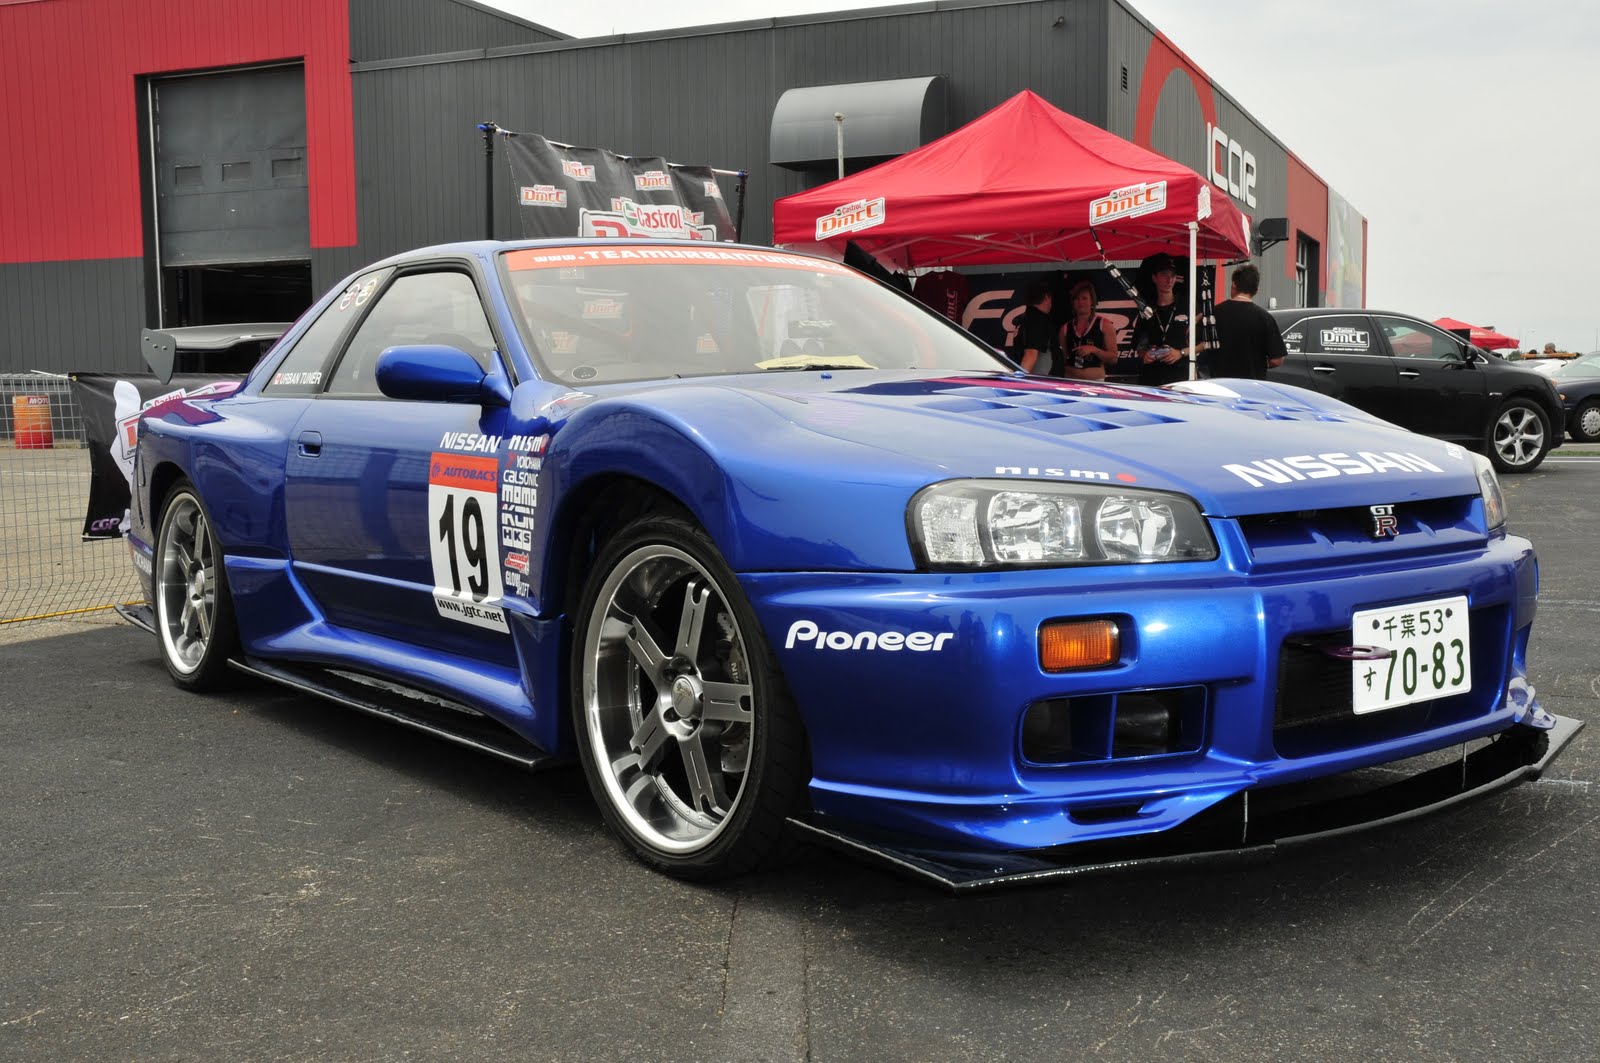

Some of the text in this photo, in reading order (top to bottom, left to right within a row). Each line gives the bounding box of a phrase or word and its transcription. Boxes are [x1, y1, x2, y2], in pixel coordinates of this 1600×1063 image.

[1118, 186, 1141, 198] Castrol
[636, 207, 683, 229] Castrol
[841, 203, 862, 214] Castrol
[439, 432, 502, 453] NISSAN
[444, 467, 496, 482] AUTOBACS
[1221, 451, 1444, 488] NISSAN
[1370, 504, 1395, 516] GT
[503, 528, 531, 545] HKS
[1374, 515, 1399, 537] R
[439, 494, 489, 603] 19
[437, 599, 504, 623] www.jgtc.net
[785, 619, 954, 652] Pioneer
[1363, 638, 1465, 701] す 70-83
